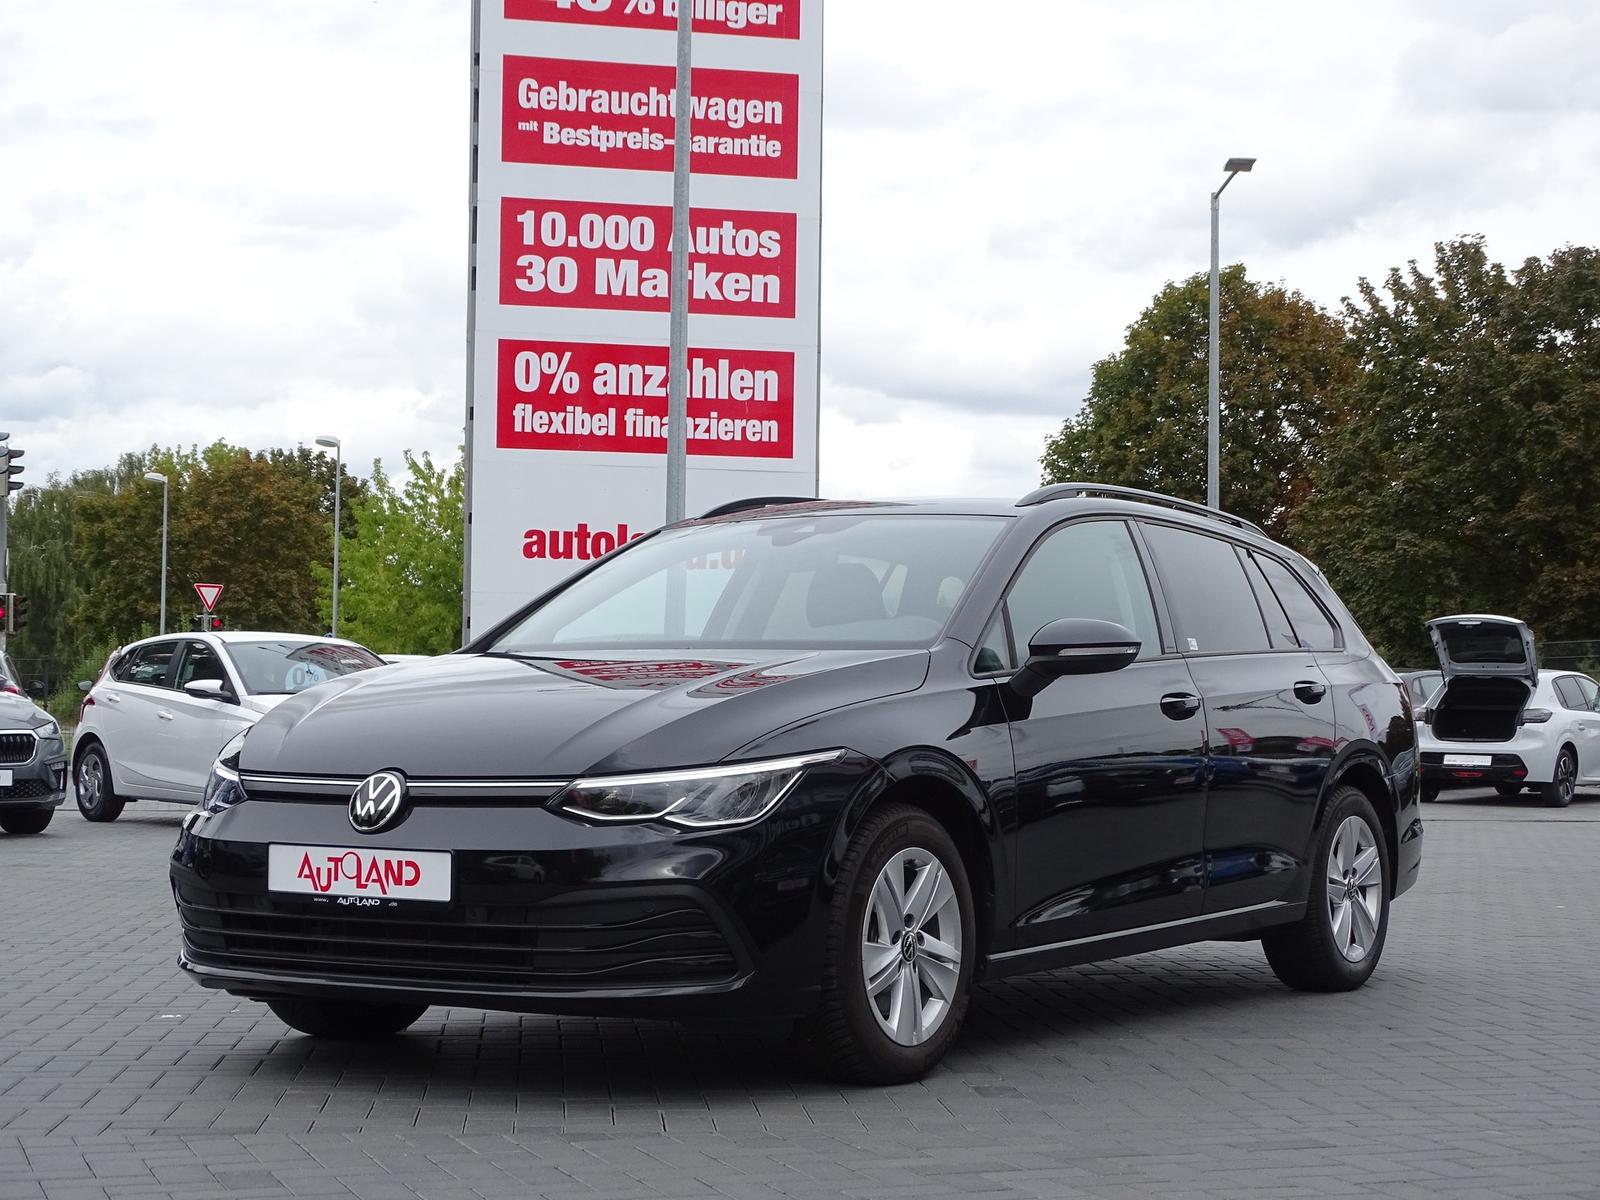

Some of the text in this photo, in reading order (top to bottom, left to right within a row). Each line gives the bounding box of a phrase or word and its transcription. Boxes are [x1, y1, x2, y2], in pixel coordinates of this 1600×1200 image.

[663, 0, 783, 29] blliger
[518, 121, 782, 158] mit Bestpreis-arantie
[516, 210, 655, 252] 10.000
[515, 255, 780, 304] 30 Maken
[514, 351, 778, 402] 0% anzhlen
[513, 403, 616, 436] flexibel
[297, 851, 421, 895] AUTOLAND
[337, 897, 381, 907] AUTOLAND
